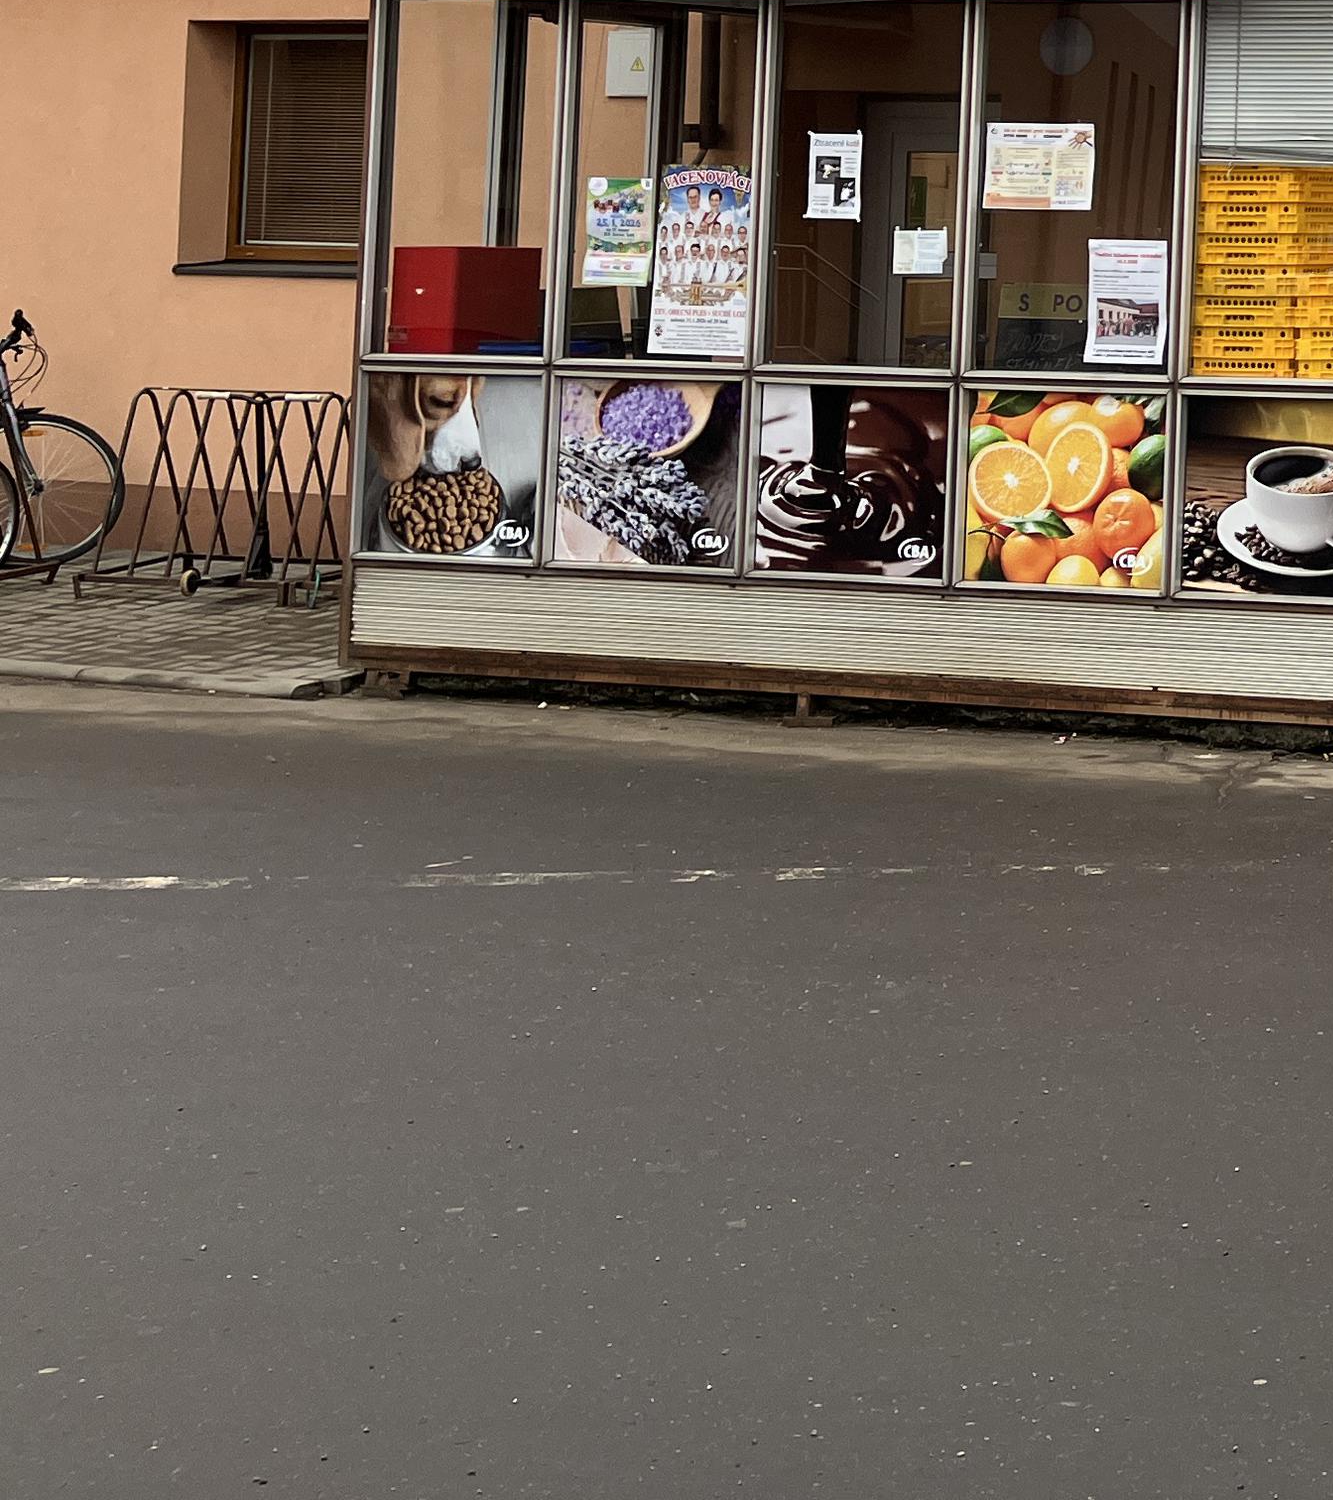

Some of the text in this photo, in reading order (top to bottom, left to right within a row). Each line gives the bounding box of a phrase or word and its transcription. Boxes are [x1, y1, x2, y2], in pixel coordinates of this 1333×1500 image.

[1018, 293, 1030, 312] S
[500, 526, 523, 540] CBA
[697, 534, 723, 548] CBA
[904, 544, 929, 559] CBA
[1119, 554, 1146, 568] CBA
